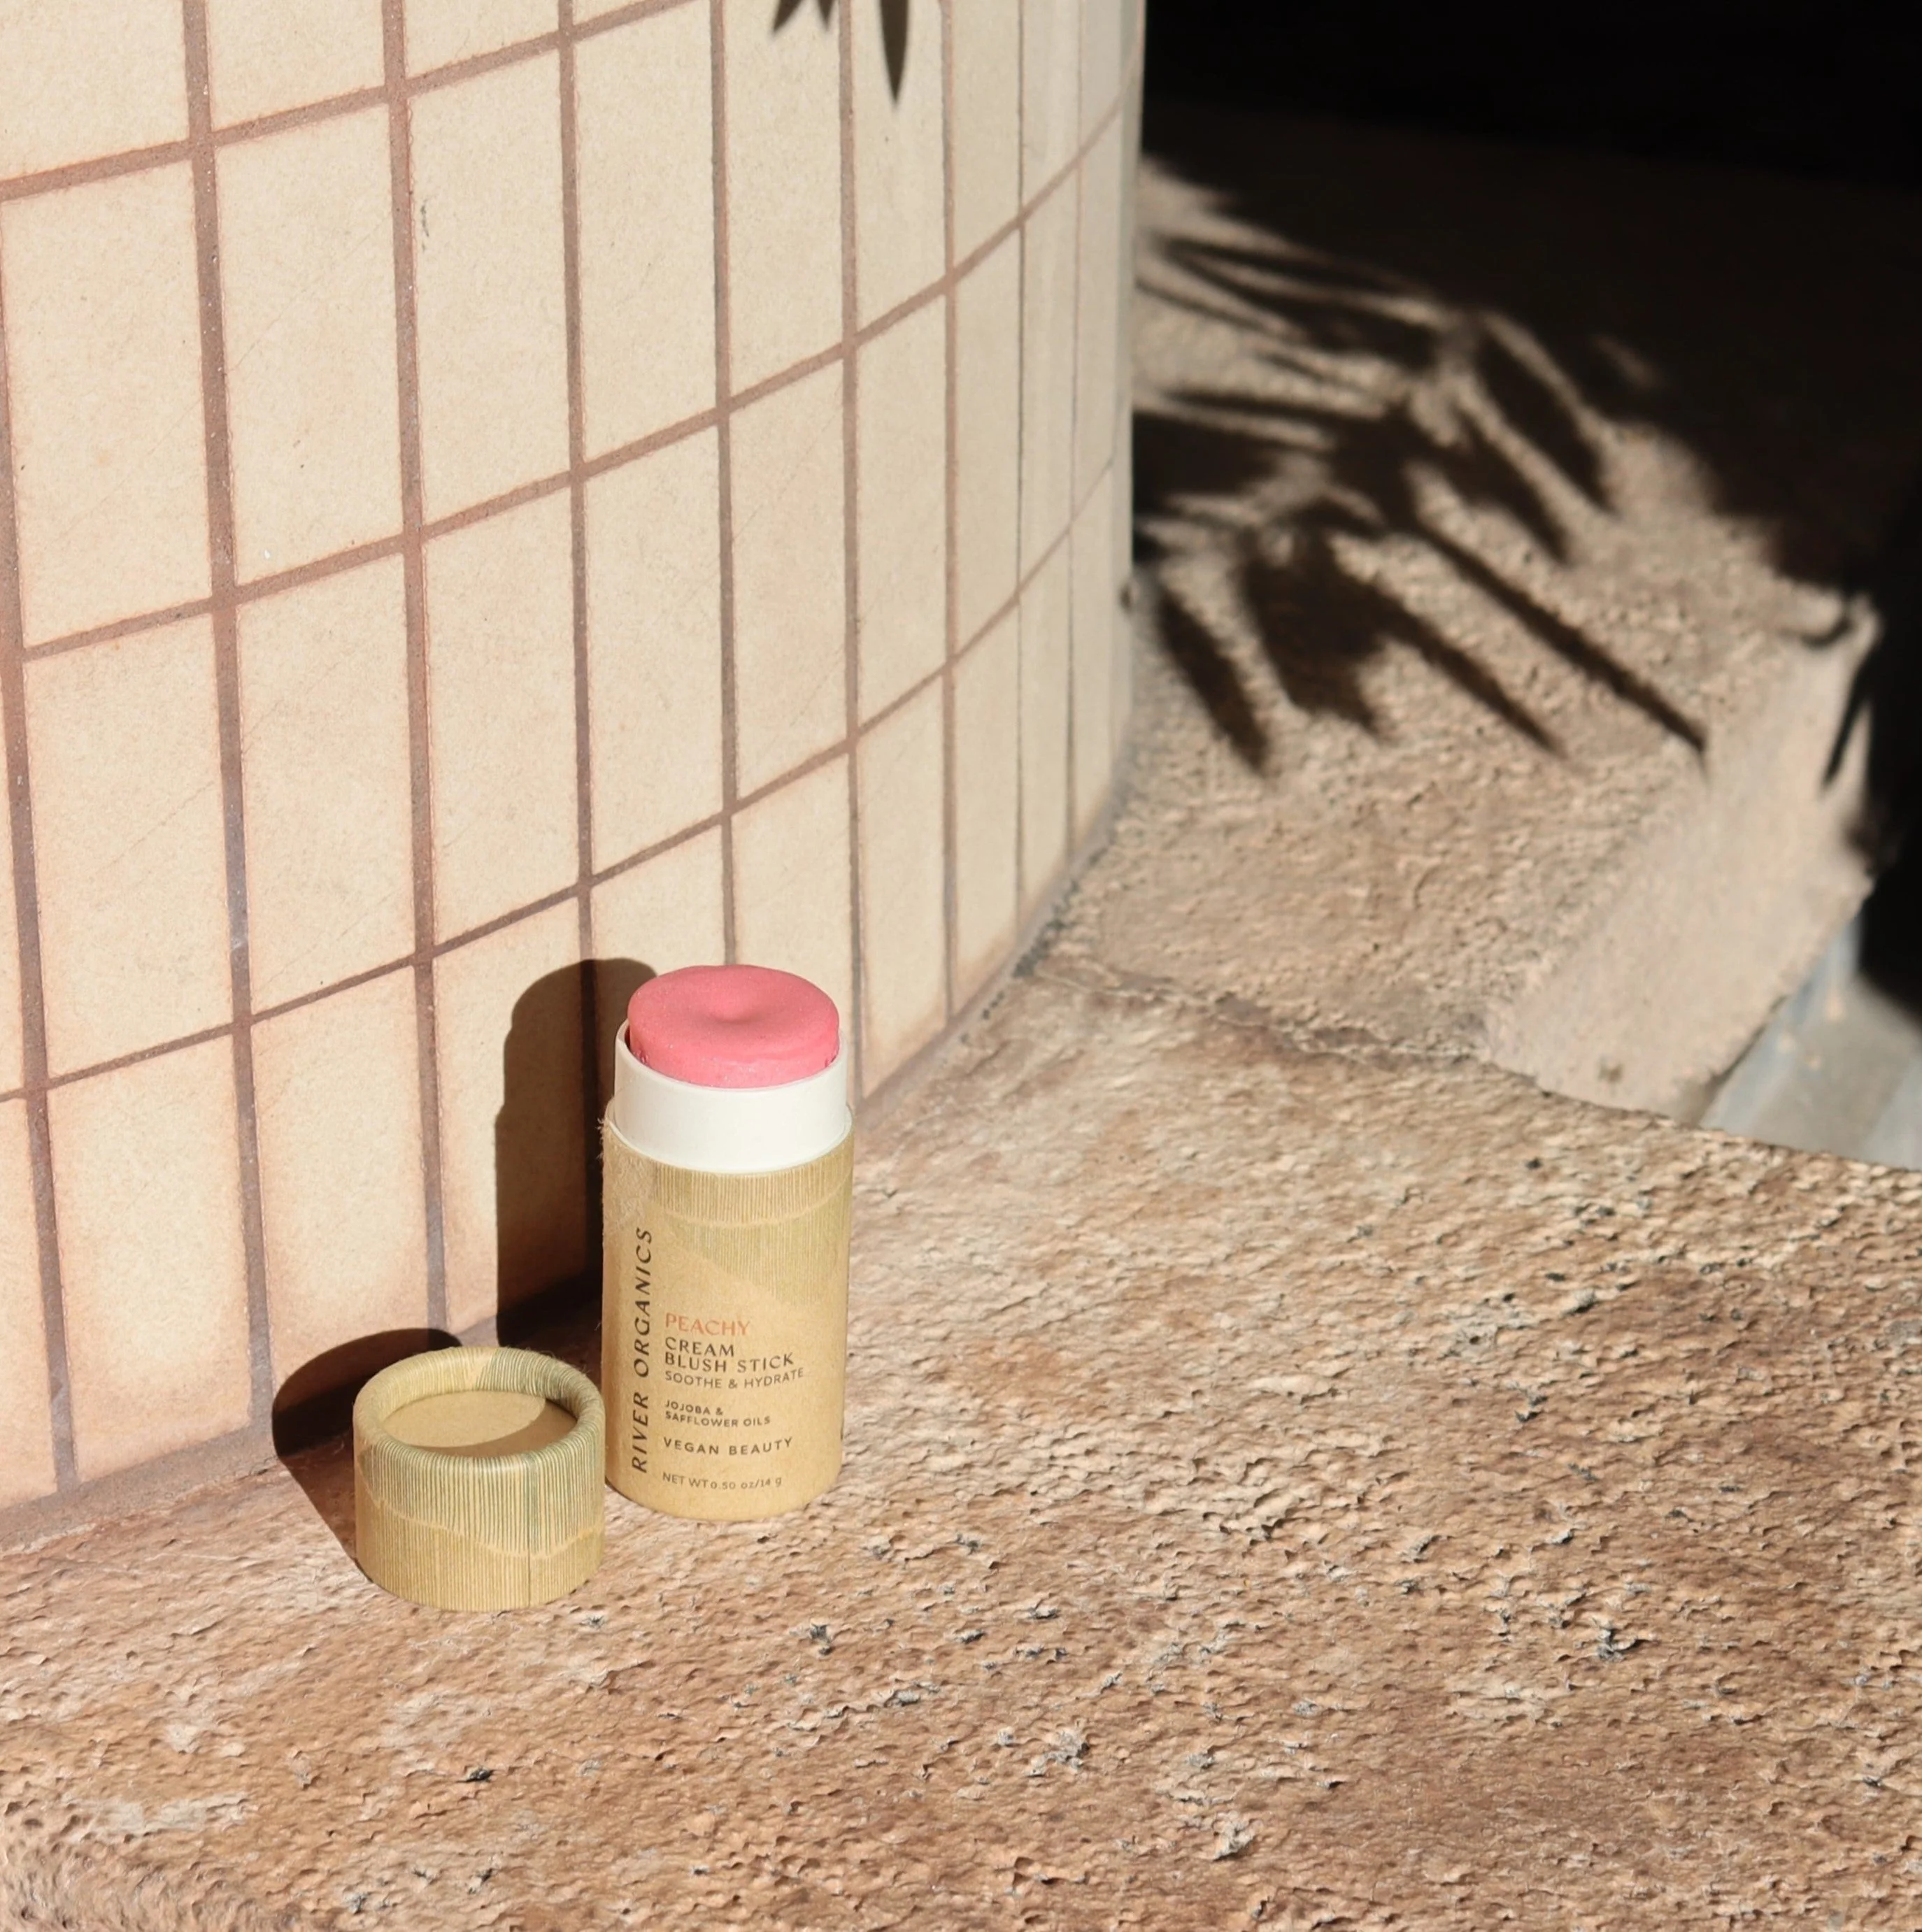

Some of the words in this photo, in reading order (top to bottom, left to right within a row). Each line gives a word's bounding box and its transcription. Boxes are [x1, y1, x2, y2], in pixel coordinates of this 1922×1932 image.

[634, 1227, 652, 1378] ORGANICS
[666, 1312, 750, 1336] PEACHY
[665, 1337, 734, 1357] CREAM
[665, 1352, 727, 1373] BLUSH
[738, 1352, 794, 1373] STICK
[665, 1371, 722, 1389] SOOTHE
[729, 1379, 738, 1389] &
[745, 1368, 804, 1389] HYDRATE
[666, 1400, 710, 1415] JOJOBA
[716, 1408, 723, 1416] &
[666, 1412, 738, 1427] SAFFLOWER
[743, 1416, 770, 1427] OILS
[632, 1392, 649, 1473] RIVER
[664, 1437, 719, 1454] VEGAN
[729, 1437, 792, 1456] BEAUTY
[663, 1473, 684, 1484] NET
